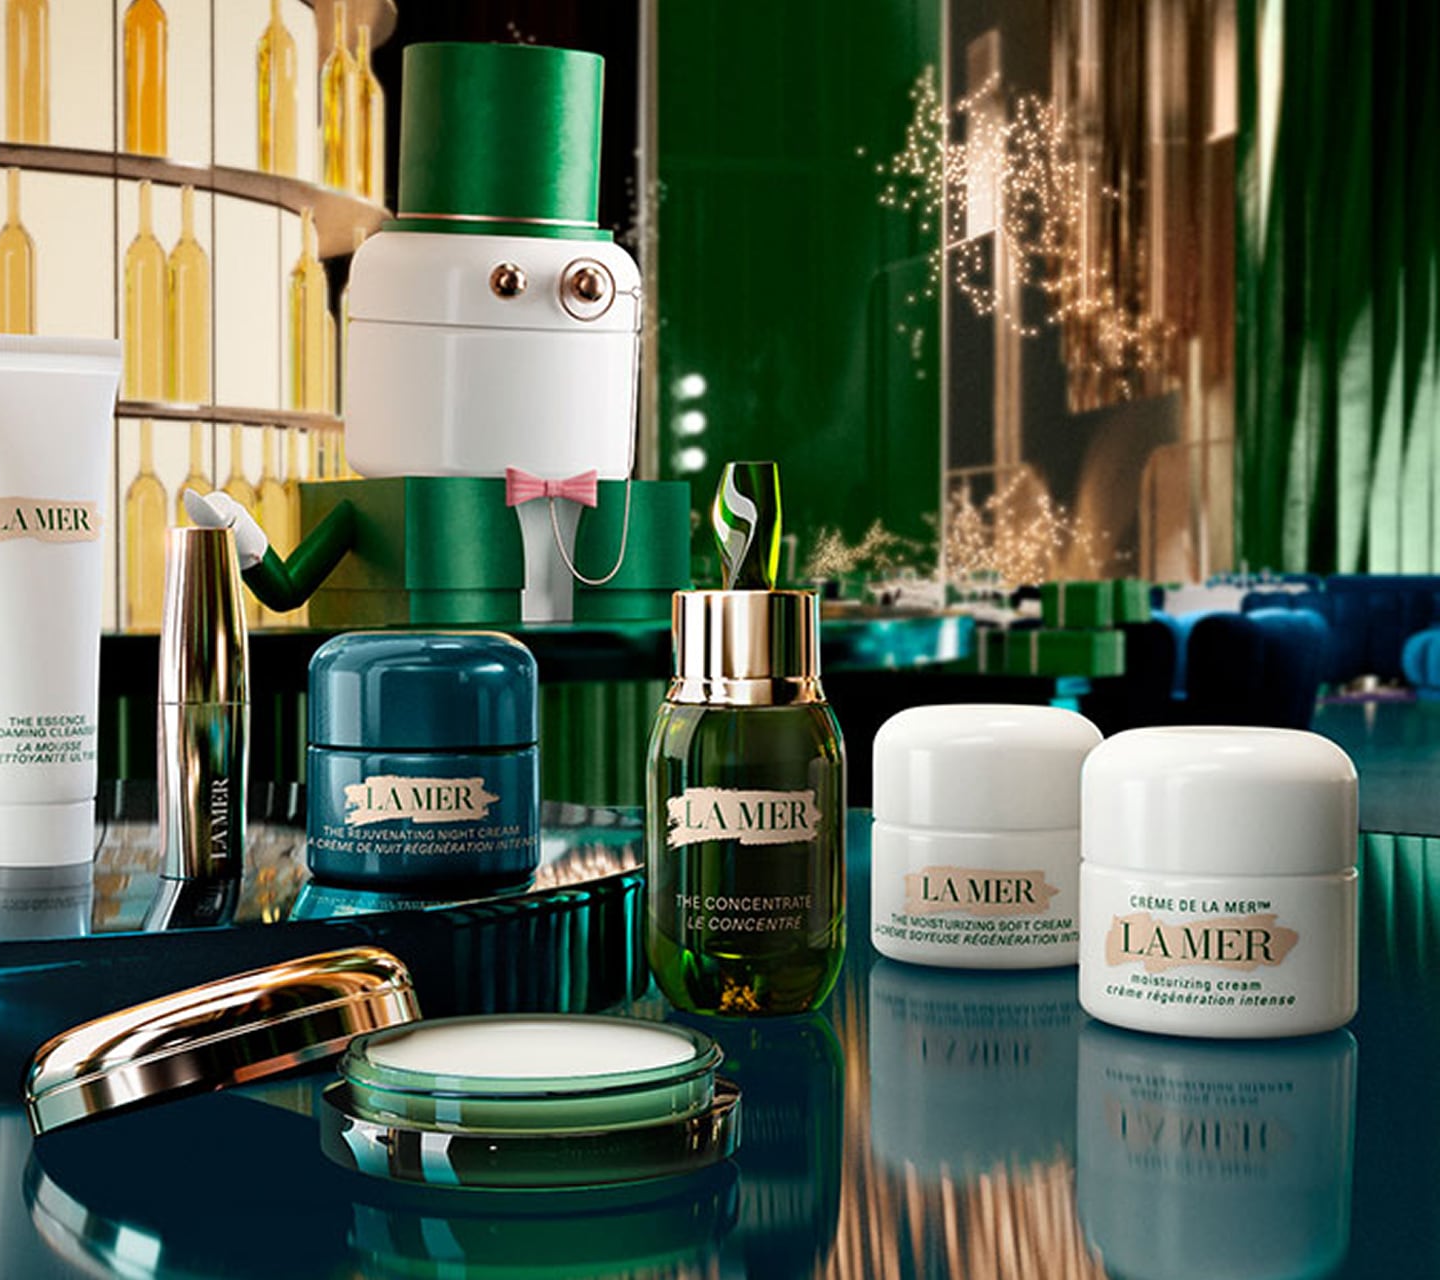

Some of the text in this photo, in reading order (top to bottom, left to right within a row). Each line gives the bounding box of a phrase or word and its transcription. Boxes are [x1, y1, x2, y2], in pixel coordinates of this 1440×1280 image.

[32, 507, 91, 531] MER
[8, 715, 85, 726] THE ESSENCE
[16, 741, 82, 753] LA MOUSSE
[366, 786, 474, 811] LA MER
[210, 778, 229, 859] LA MER
[686, 801, 808, 830] LA MER
[323, 825, 520, 842] THE REJUVENATING NIGHT CREAM
[356, 842, 372, 853] DE
[374, 843, 402, 854] NUIT
[922, 876, 1035, 903] LA MER
[676, 894, 812, 911] THE CONCENTRATE
[1130, 894, 1173, 911] CRÈME
[1179, 900, 1196, 911] DE
[1202, 901, 1220, 913] LA
[687, 915, 802, 931] LE CONCENTRÉ
[891, 913, 1072, 932] THE MOISTURIZING SOFT CREAM
[910, 930, 961, 944] SOYEUSE
[1121, 920, 1275, 962] LA MER
[1131, 974, 1262, 991] moisturizing cream
[1106, 984, 1143, 999] crème
[1239, 993, 1296, 1006] intense
